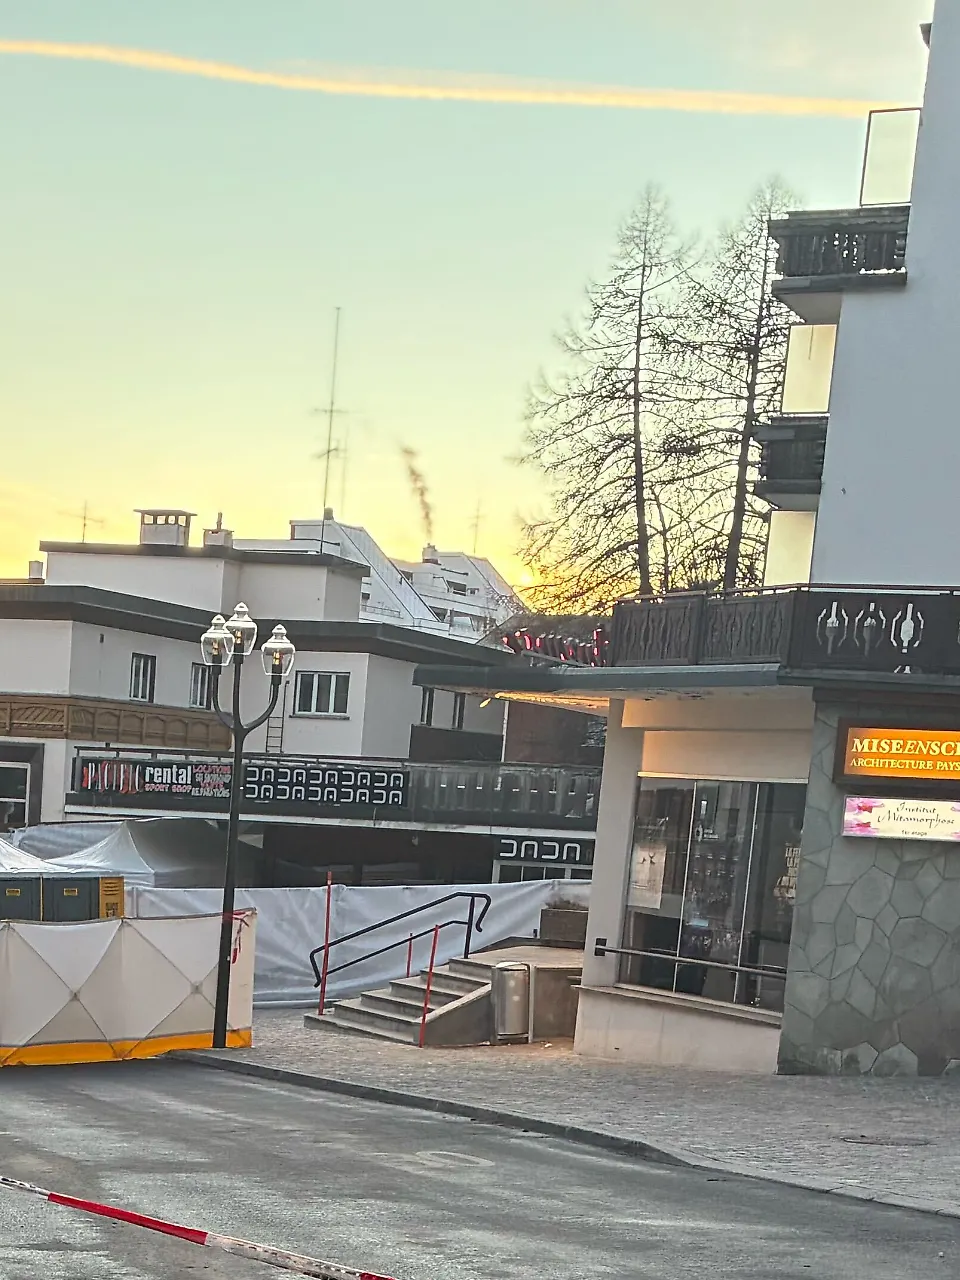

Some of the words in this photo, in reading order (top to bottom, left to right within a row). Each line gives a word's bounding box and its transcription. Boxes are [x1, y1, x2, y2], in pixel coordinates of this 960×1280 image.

[850, 758, 933, 770] ARCHITECTURE
[145, 764, 191, 784] rental
[896, 801, 937, 814] Institut
